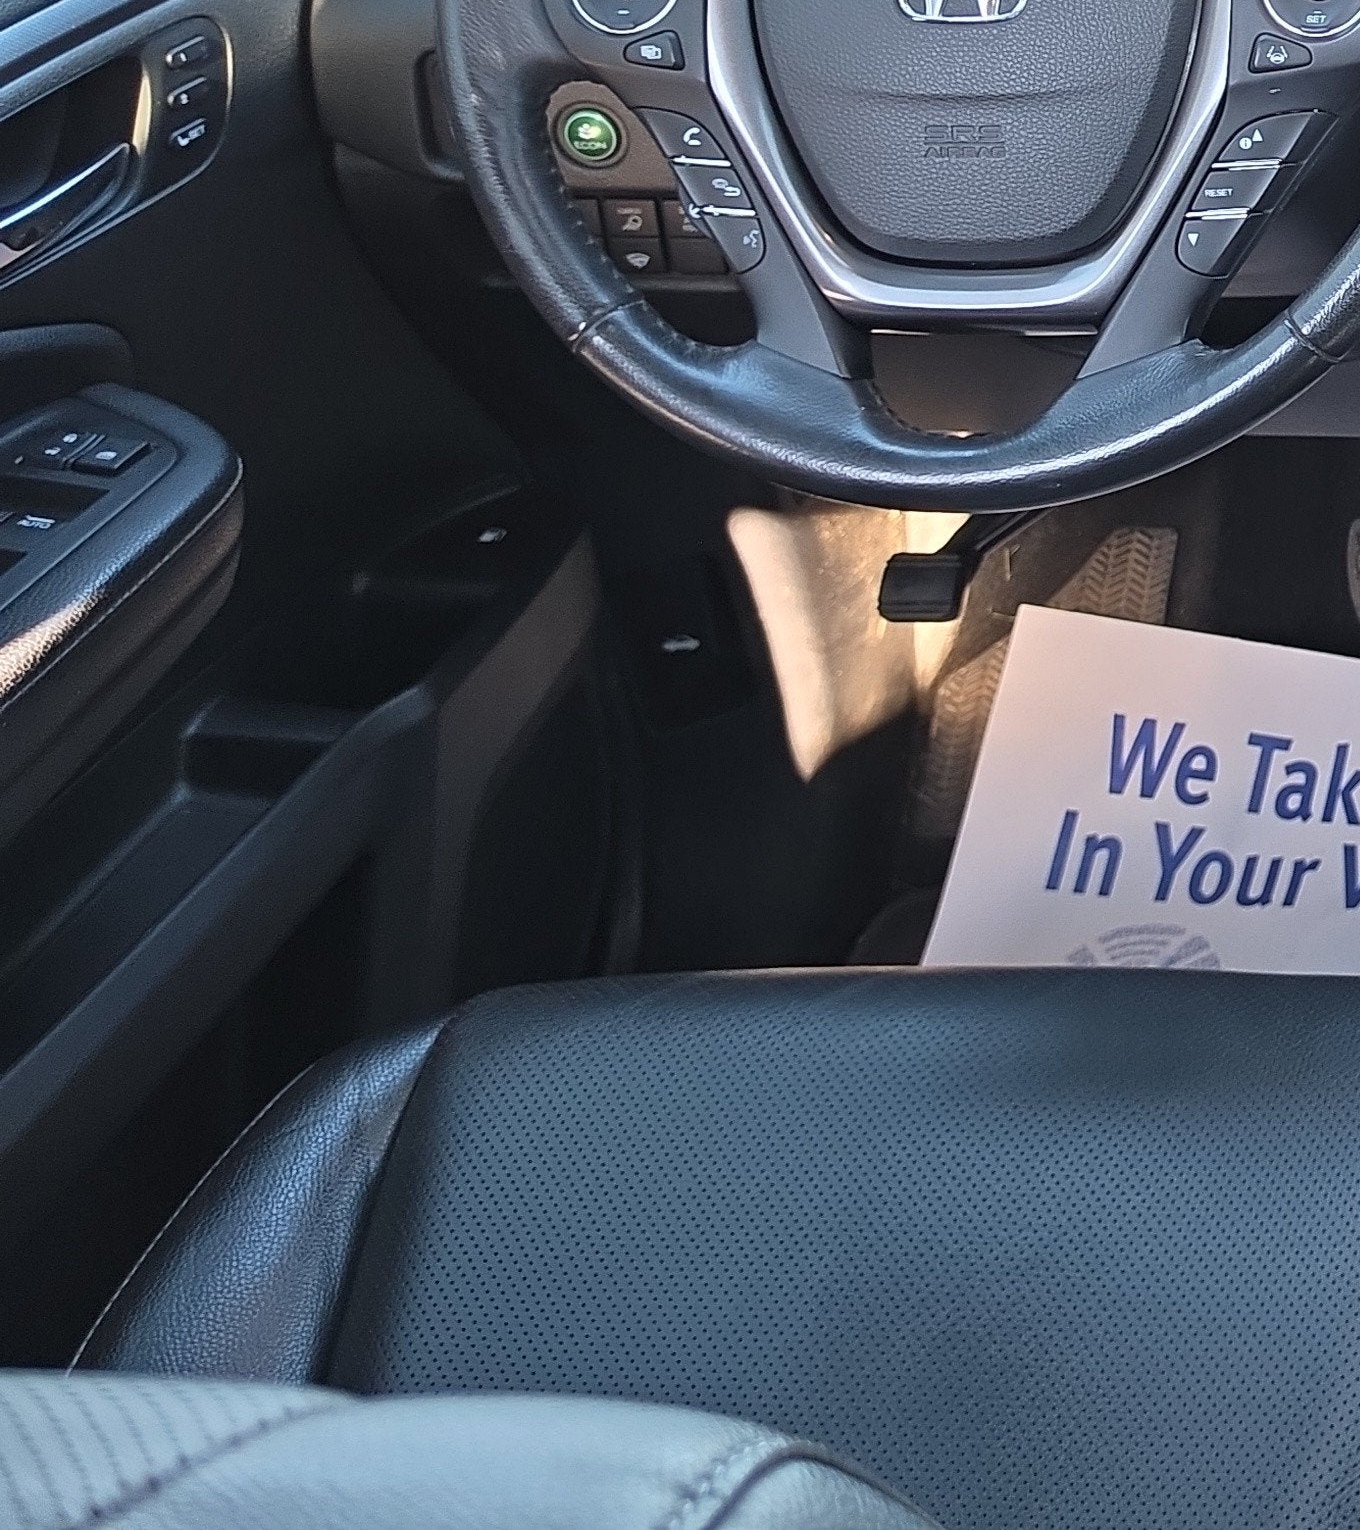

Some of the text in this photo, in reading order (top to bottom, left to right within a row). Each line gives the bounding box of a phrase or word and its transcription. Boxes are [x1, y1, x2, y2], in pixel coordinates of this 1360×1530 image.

[1305, 14, 1327, 24] SET
[924, 124, 1003, 142] SRS
[1204, 188, 1233, 198] RESET
[1107, 713, 1219, 804] We
[1044, 809, 1124, 897] In
[1152, 819, 1321, 910] Your
